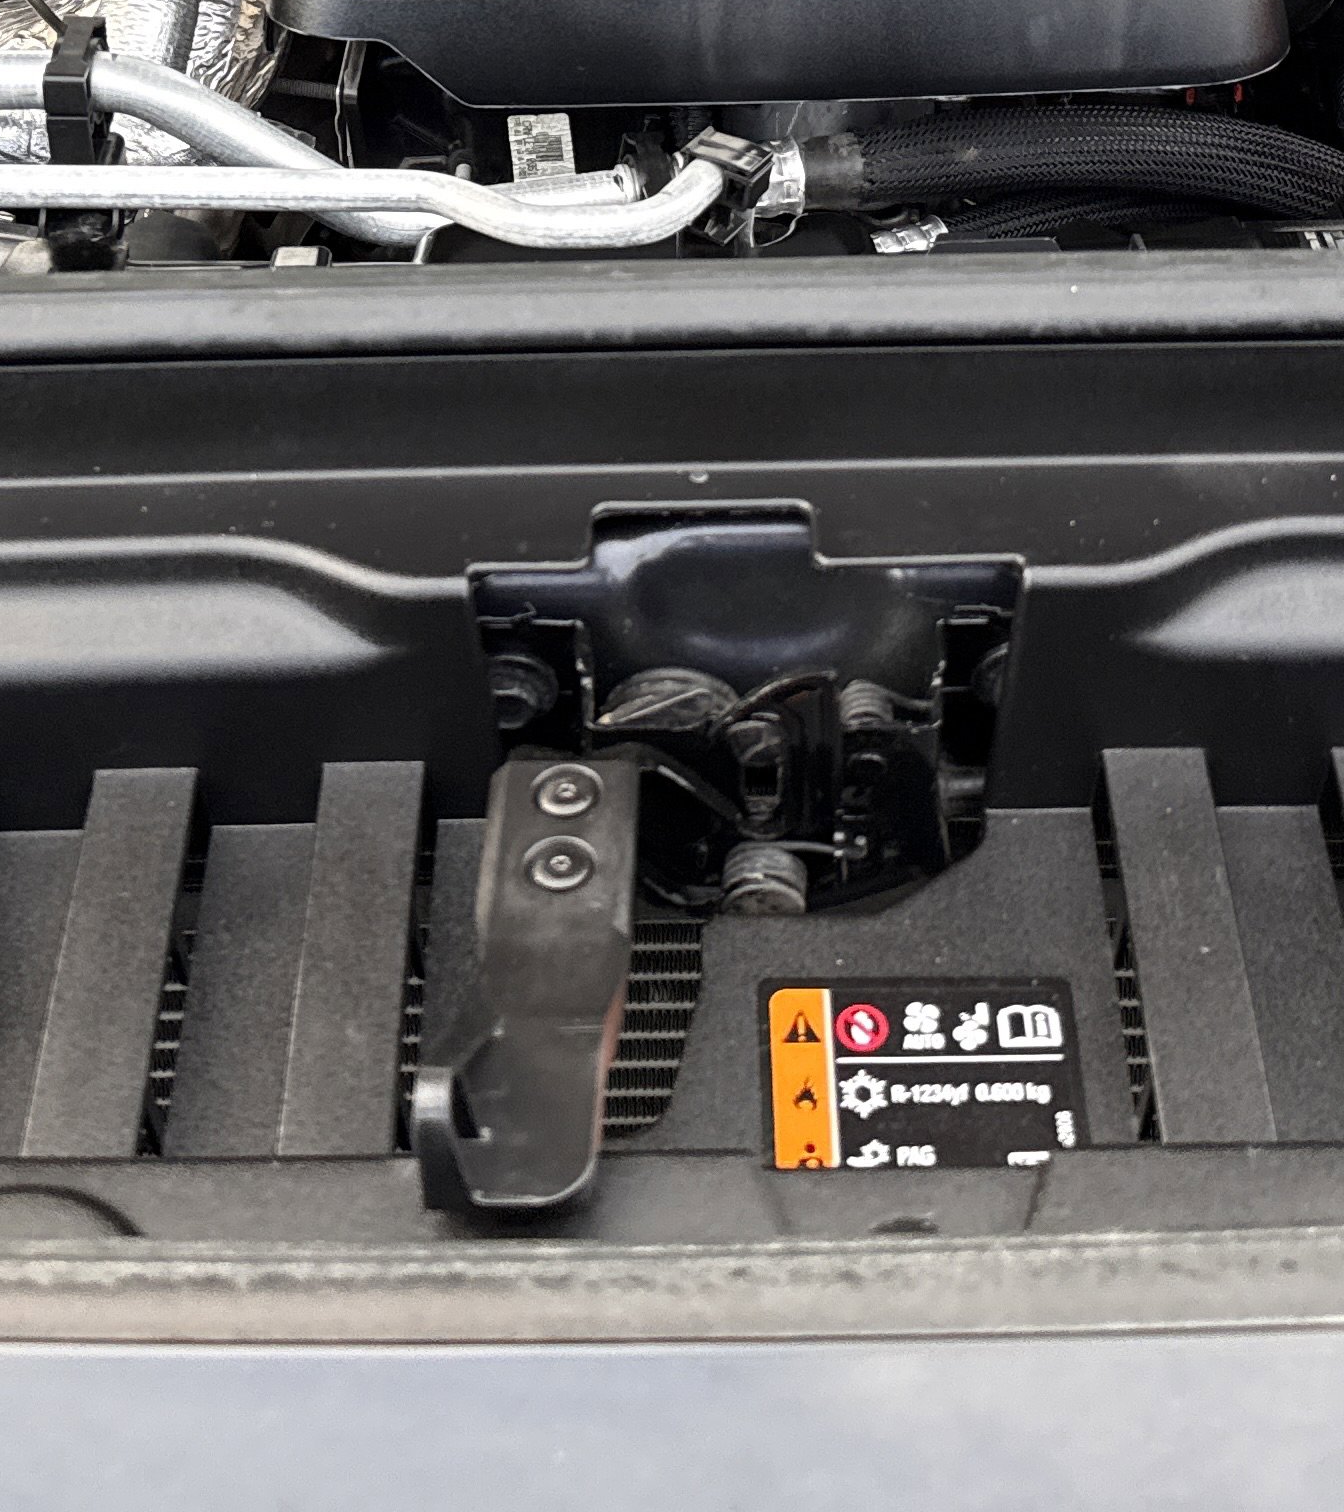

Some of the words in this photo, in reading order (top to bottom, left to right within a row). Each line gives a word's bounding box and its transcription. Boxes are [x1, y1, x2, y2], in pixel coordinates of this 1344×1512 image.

[902, 1033, 946, 1050] AUTO
[1026, 1081, 1052, 1105] kg
[896, 1144, 937, 1167] PAG
